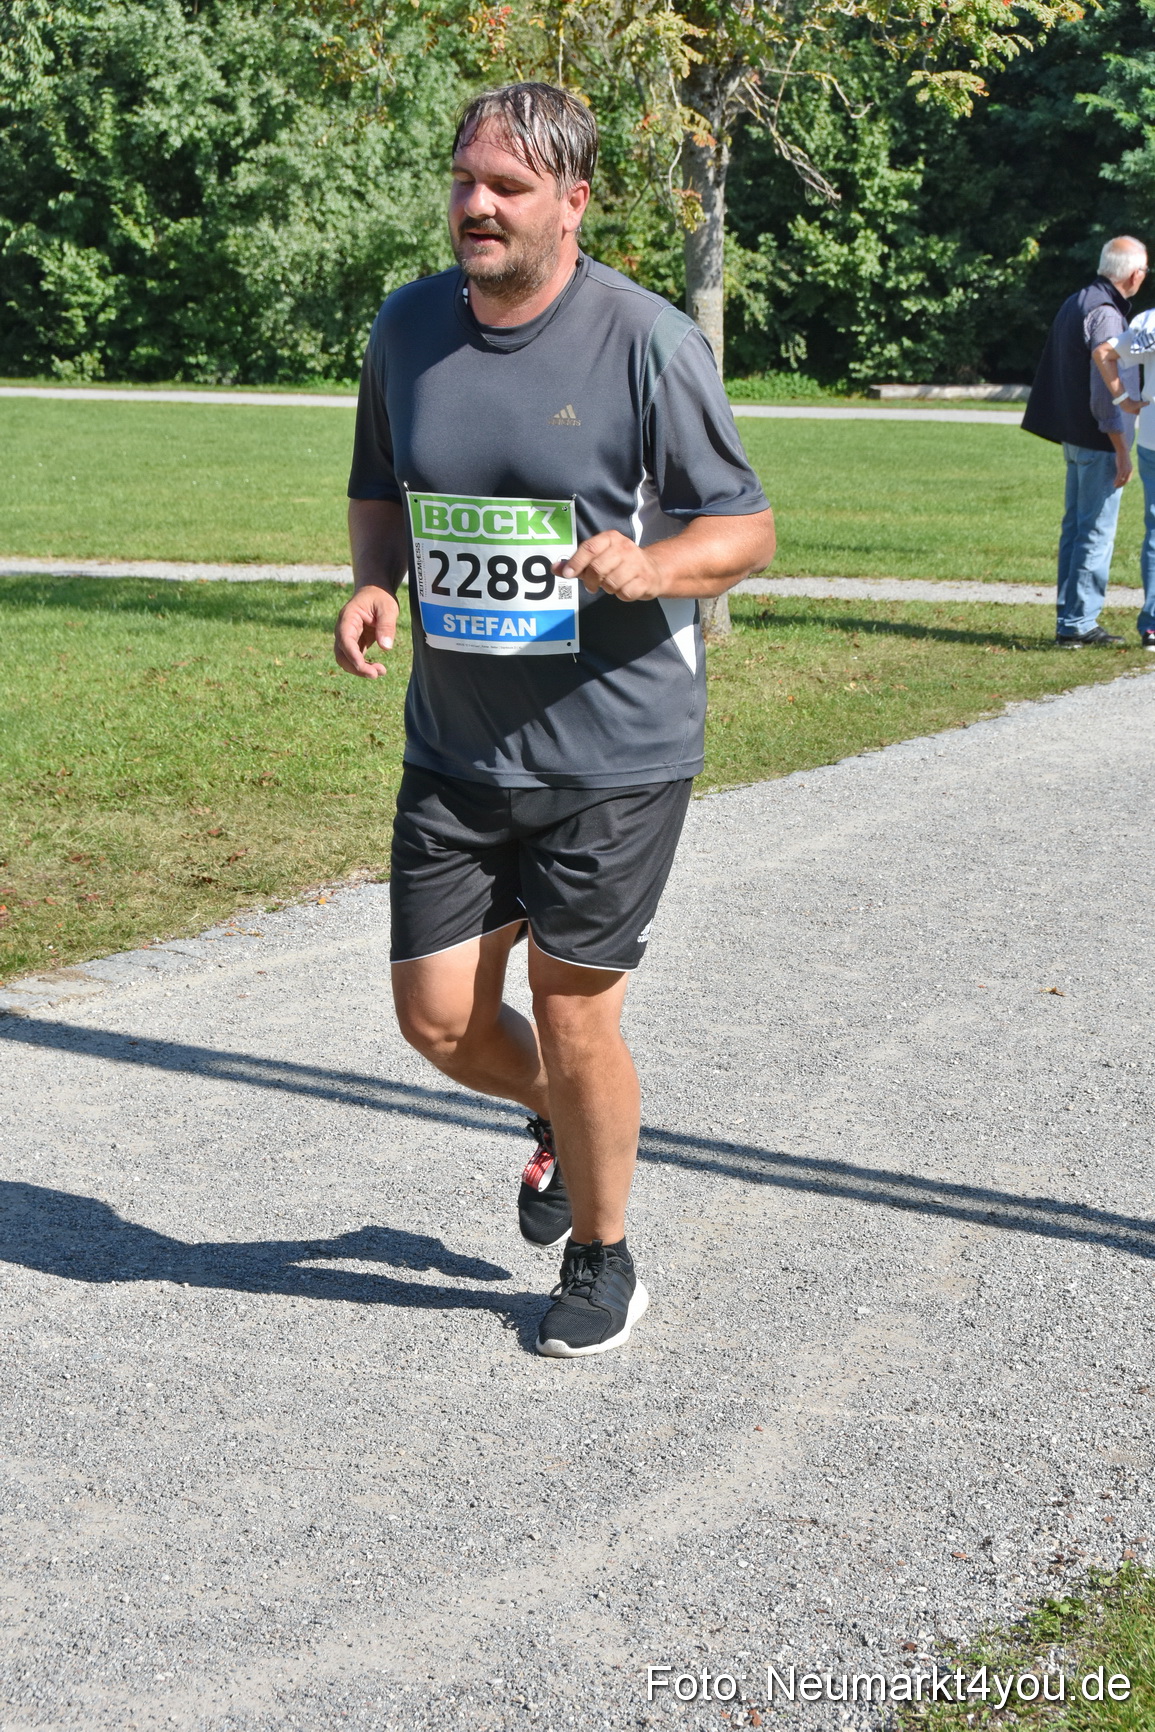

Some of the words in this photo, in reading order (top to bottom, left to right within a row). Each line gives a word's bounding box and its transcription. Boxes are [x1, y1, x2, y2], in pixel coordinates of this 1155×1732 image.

[422, 503, 556, 537] BOCK
[429, 550, 556, 601] 2289
[443, 613, 537, 637] STEFAN
